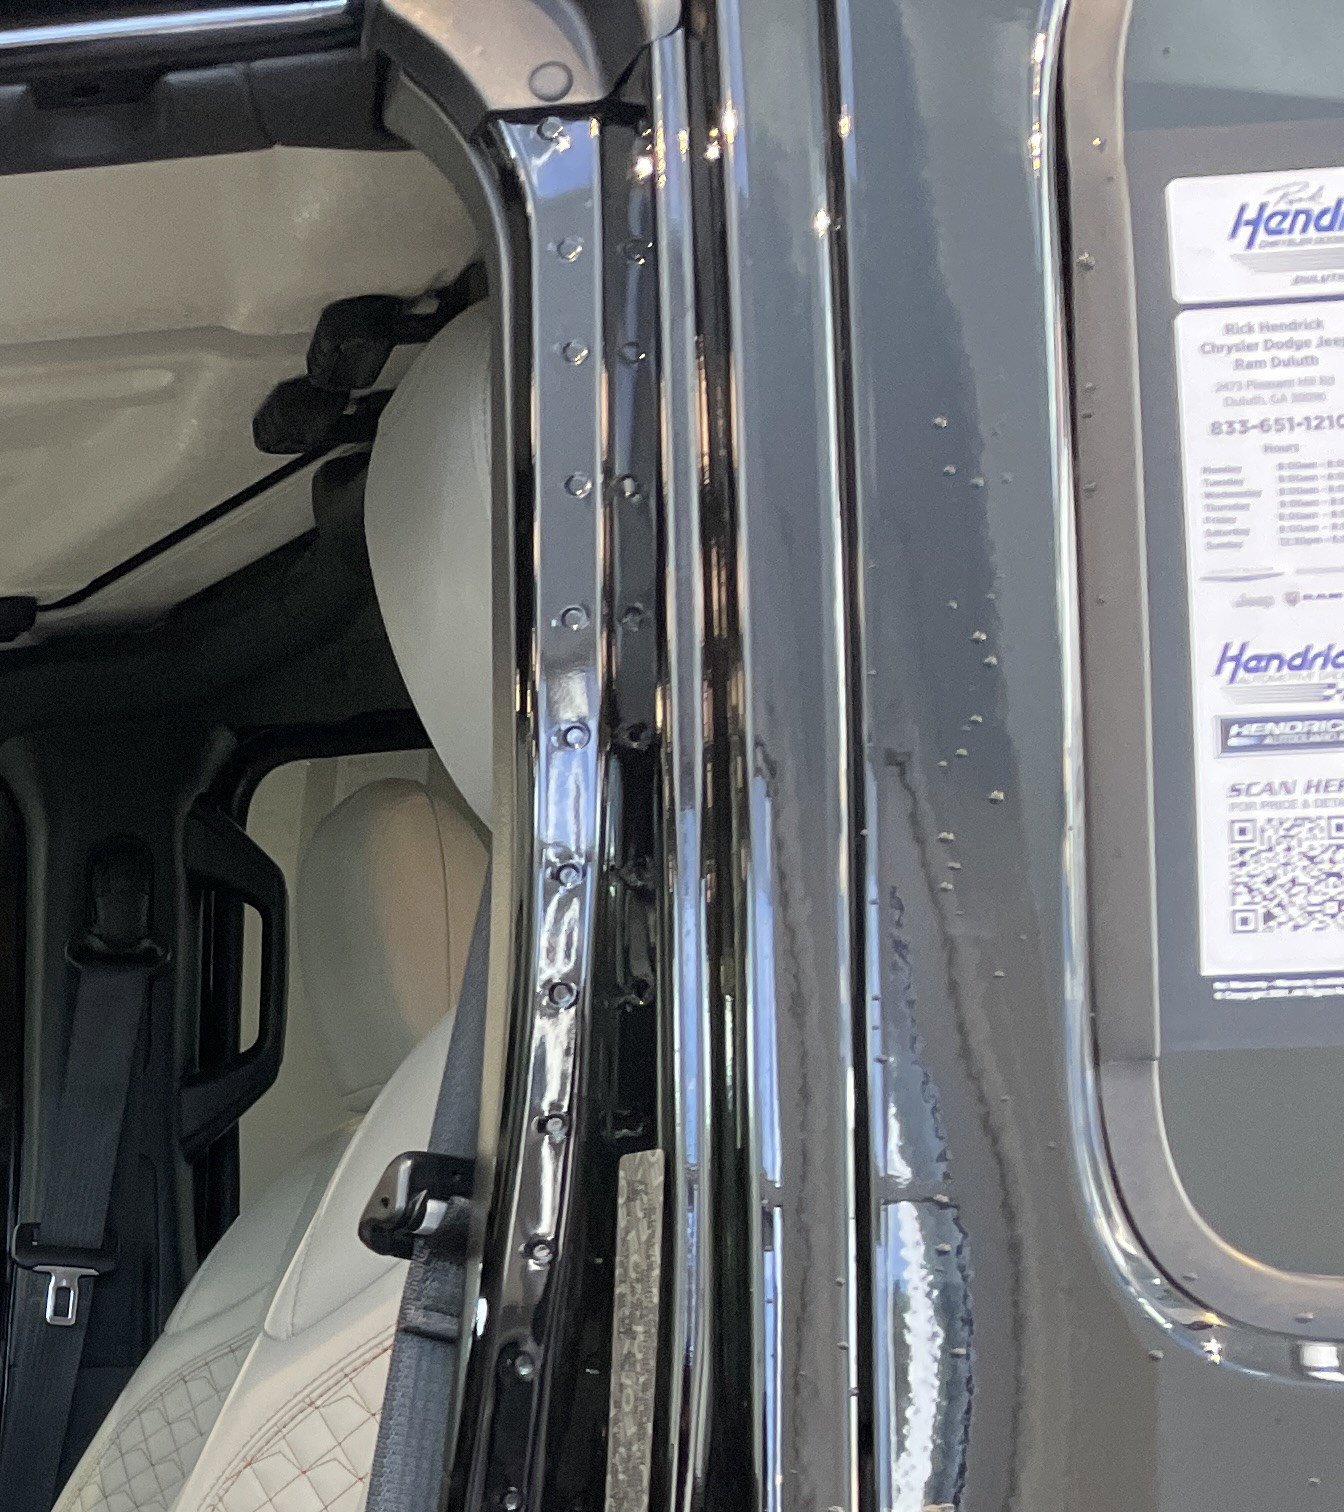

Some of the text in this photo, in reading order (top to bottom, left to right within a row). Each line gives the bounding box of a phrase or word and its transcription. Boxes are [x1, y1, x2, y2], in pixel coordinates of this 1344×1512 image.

[1224, 318, 1324, 335] Rick Hendrick
[1200, 335, 1344, 355] Chrysler Dodge Jee
[1233, 355, 1319, 371] Ram Duluth
[1210, 414, 1344, 435] 833-651-1210
[1227, 781, 1297, 798] SCAN
